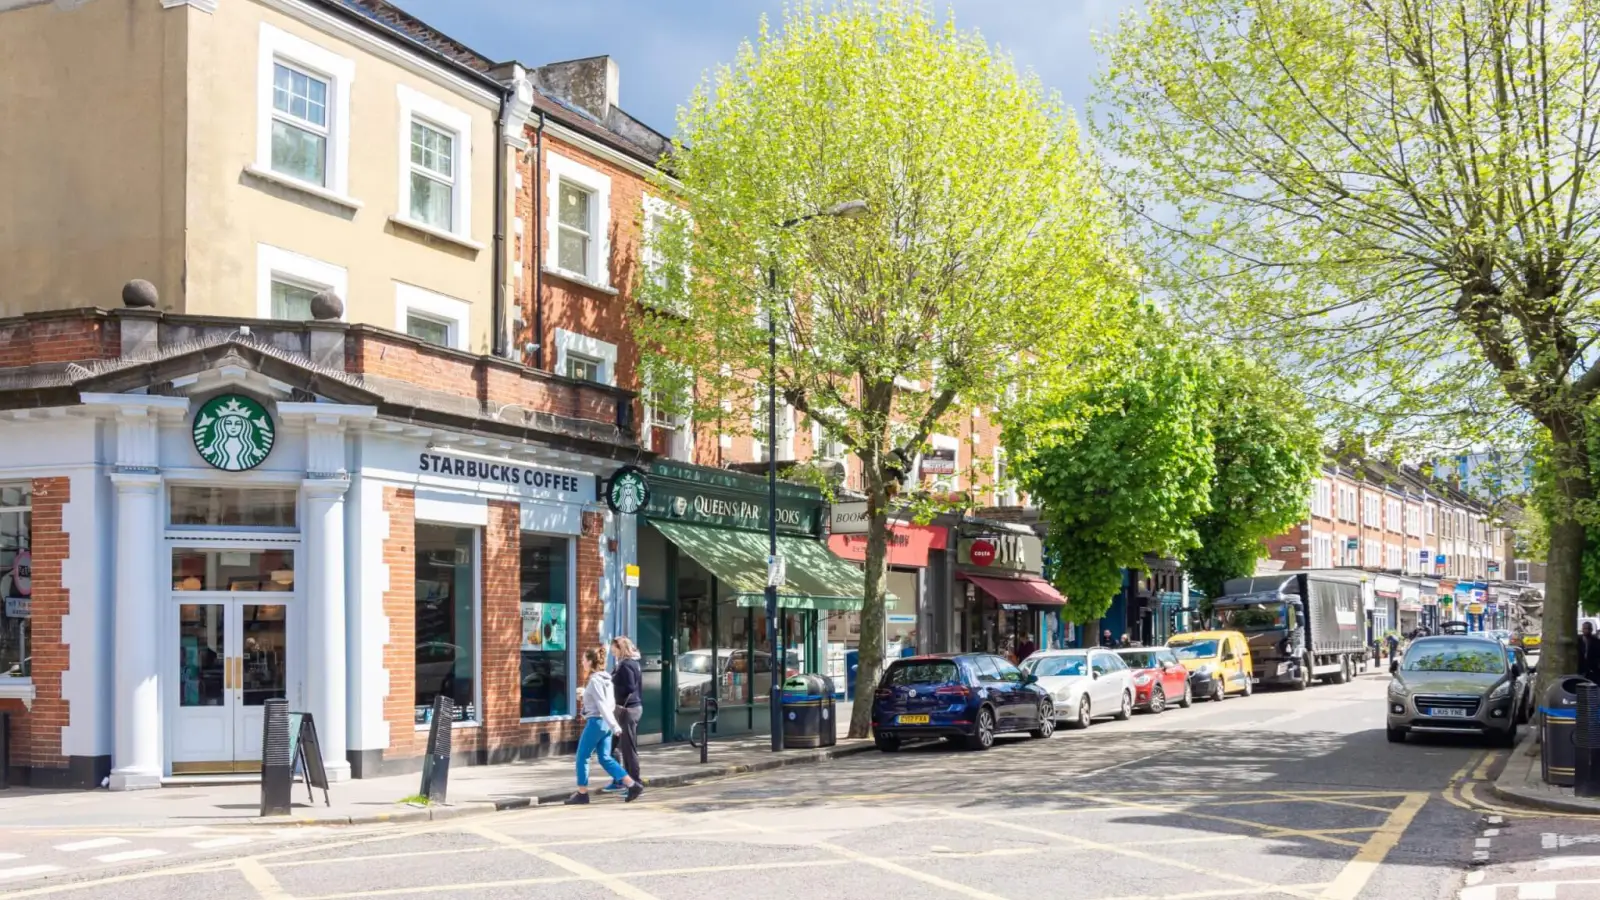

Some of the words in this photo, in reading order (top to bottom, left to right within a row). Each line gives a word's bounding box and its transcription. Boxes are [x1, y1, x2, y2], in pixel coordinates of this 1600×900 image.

[419, 453, 520, 484] STARBUCKS
[524, 469, 578, 492] COFFEE
[694, 495, 738, 518] QUEENS
[740, 501, 767, 520] PAR
[774, 507, 800, 524] OOKS
